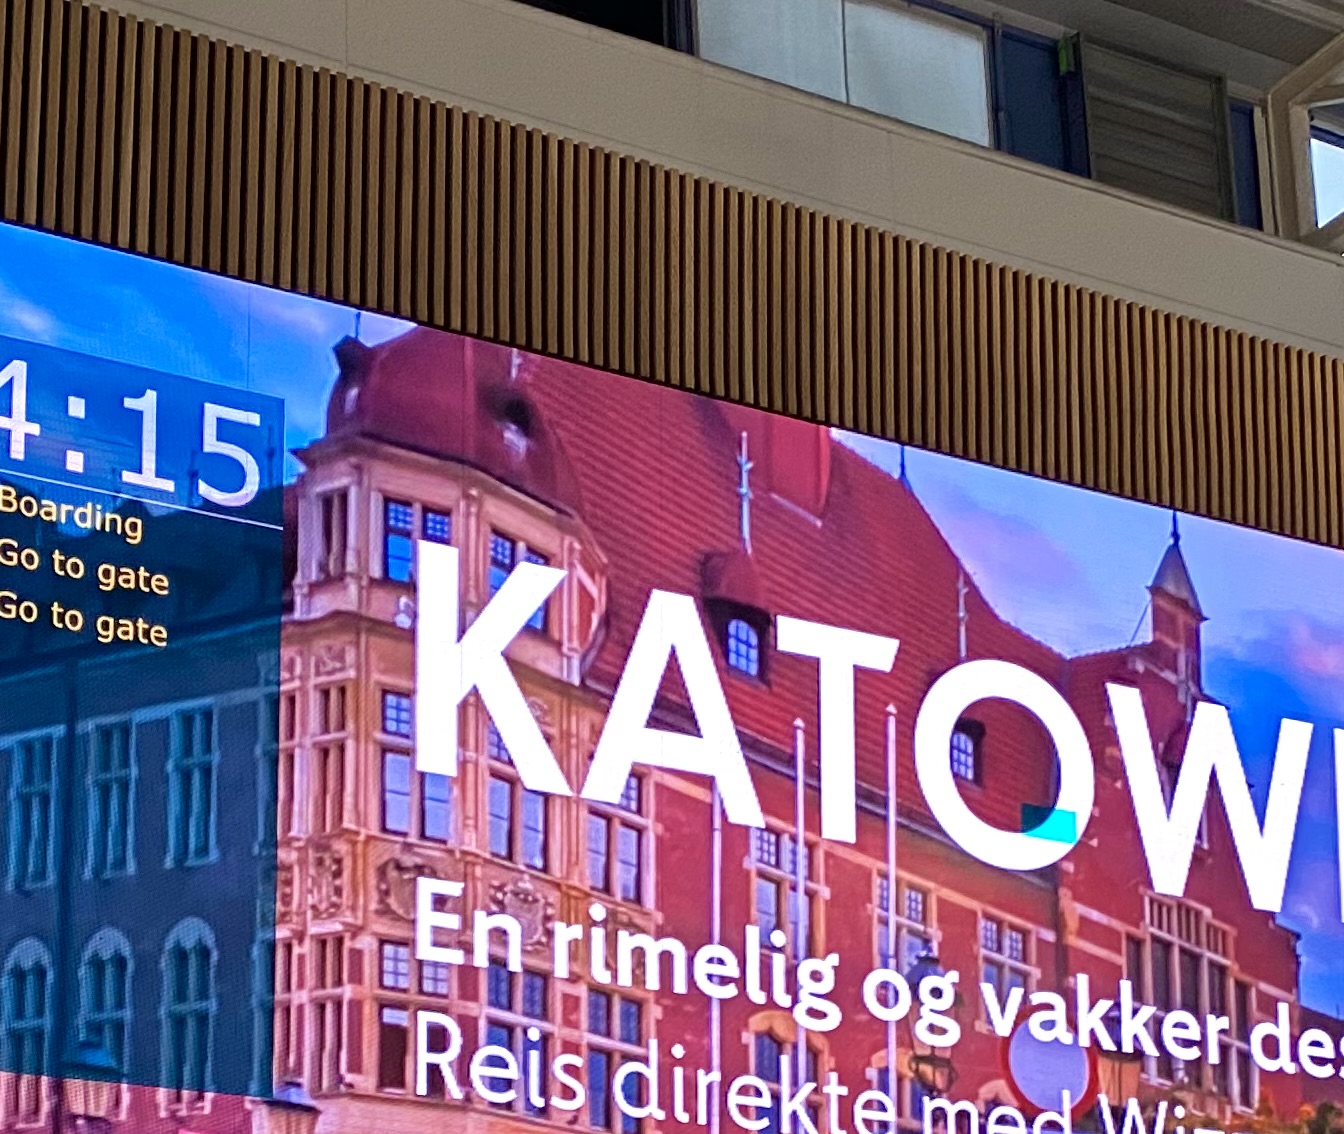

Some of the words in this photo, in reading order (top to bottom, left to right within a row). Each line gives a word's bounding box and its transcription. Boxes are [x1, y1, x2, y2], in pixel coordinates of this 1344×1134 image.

[52, 549, 85, 579] to
[97, 562, 169, 595] gate
[51, 601, 84, 632] to
[96, 615, 168, 647] gate
[415, 876, 524, 968] En
[551, 901, 838, 1032] rimelig
[862, 963, 959, 1047] og
[979, 972, 1230, 1067] vakker
[415, 1008, 586, 1110] Reis
